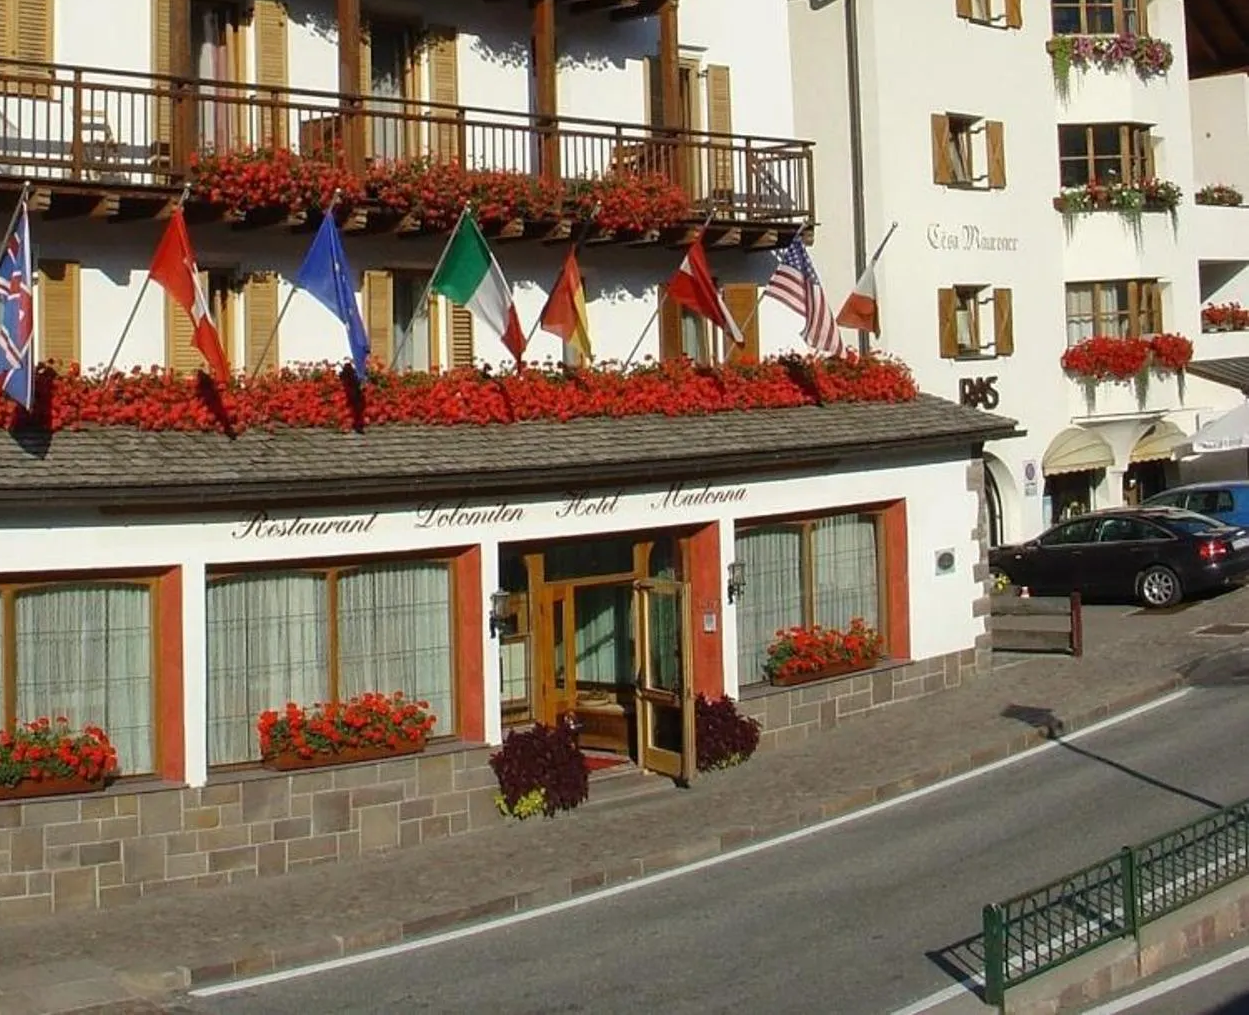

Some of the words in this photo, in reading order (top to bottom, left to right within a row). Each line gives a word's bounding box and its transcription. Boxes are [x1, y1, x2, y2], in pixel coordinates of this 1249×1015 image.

[232, 508, 379, 539] Restaurant
[414, 498, 525, 529] Dolomiten
[555, 488, 623, 519] Hotel
[650, 479, 748, 510] Madonna
